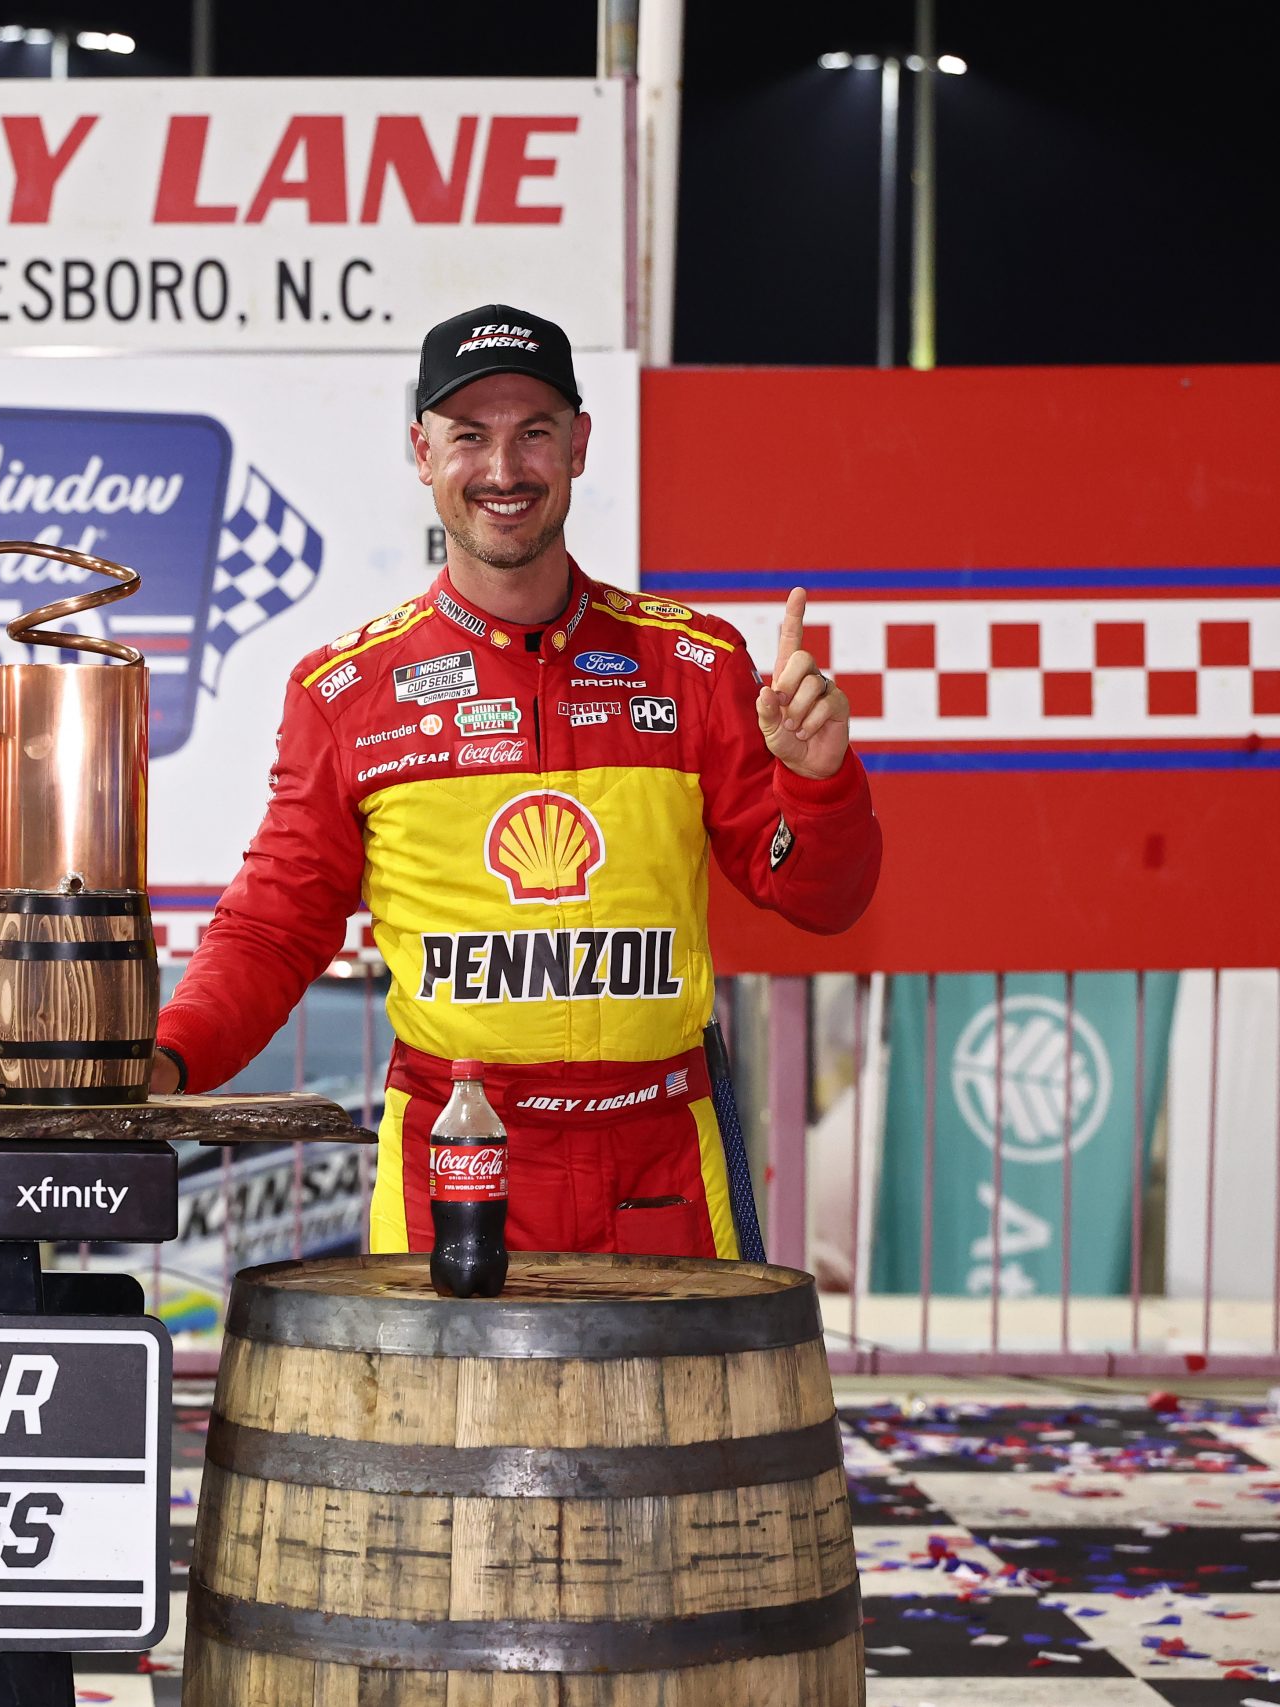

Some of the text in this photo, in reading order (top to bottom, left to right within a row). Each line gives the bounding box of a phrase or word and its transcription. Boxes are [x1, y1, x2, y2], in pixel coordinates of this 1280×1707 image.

[152, 114, 580, 226] LANE
[275, 258, 394, 323] N.C.
[471, 324, 533, 338] TEAM
[455, 337, 540, 358] PENSKE
[434, 590, 488, 638] PENNZOIL
[645, 605, 685, 616] PENNZOIL
[419, 655, 461, 676] NASCAR
[585, 652, 626, 672] Ford
[675, 640, 715, 667] OMP
[320, 664, 358, 698] OMP
[407, 671, 464, 693] CUP SERIES
[570, 678, 647, 689] RACING
[423, 687, 472, 704] CHAMPION 3X
[459, 711, 516, 724] BROTHERS
[471, 703, 503, 715] HUNT
[571, 714, 603, 724] TIRE
[632, 700, 675, 729] PPG
[355, 722, 418, 748] Autotrader
[472, 719, 506, 731] PIZZA
[457, 739, 526, 766] Coca-Cola
[357, 751, 451, 782] GOODYEAR
[417, 929, 684, 1001] PENNZOIL
[516, 1084, 659, 1112] JOEY LOGANO
[435, 1148, 504, 1176] Coca-Cola
[16, 1176, 129, 1214] xfinity
[178, 1147, 378, 1243] KANSA
